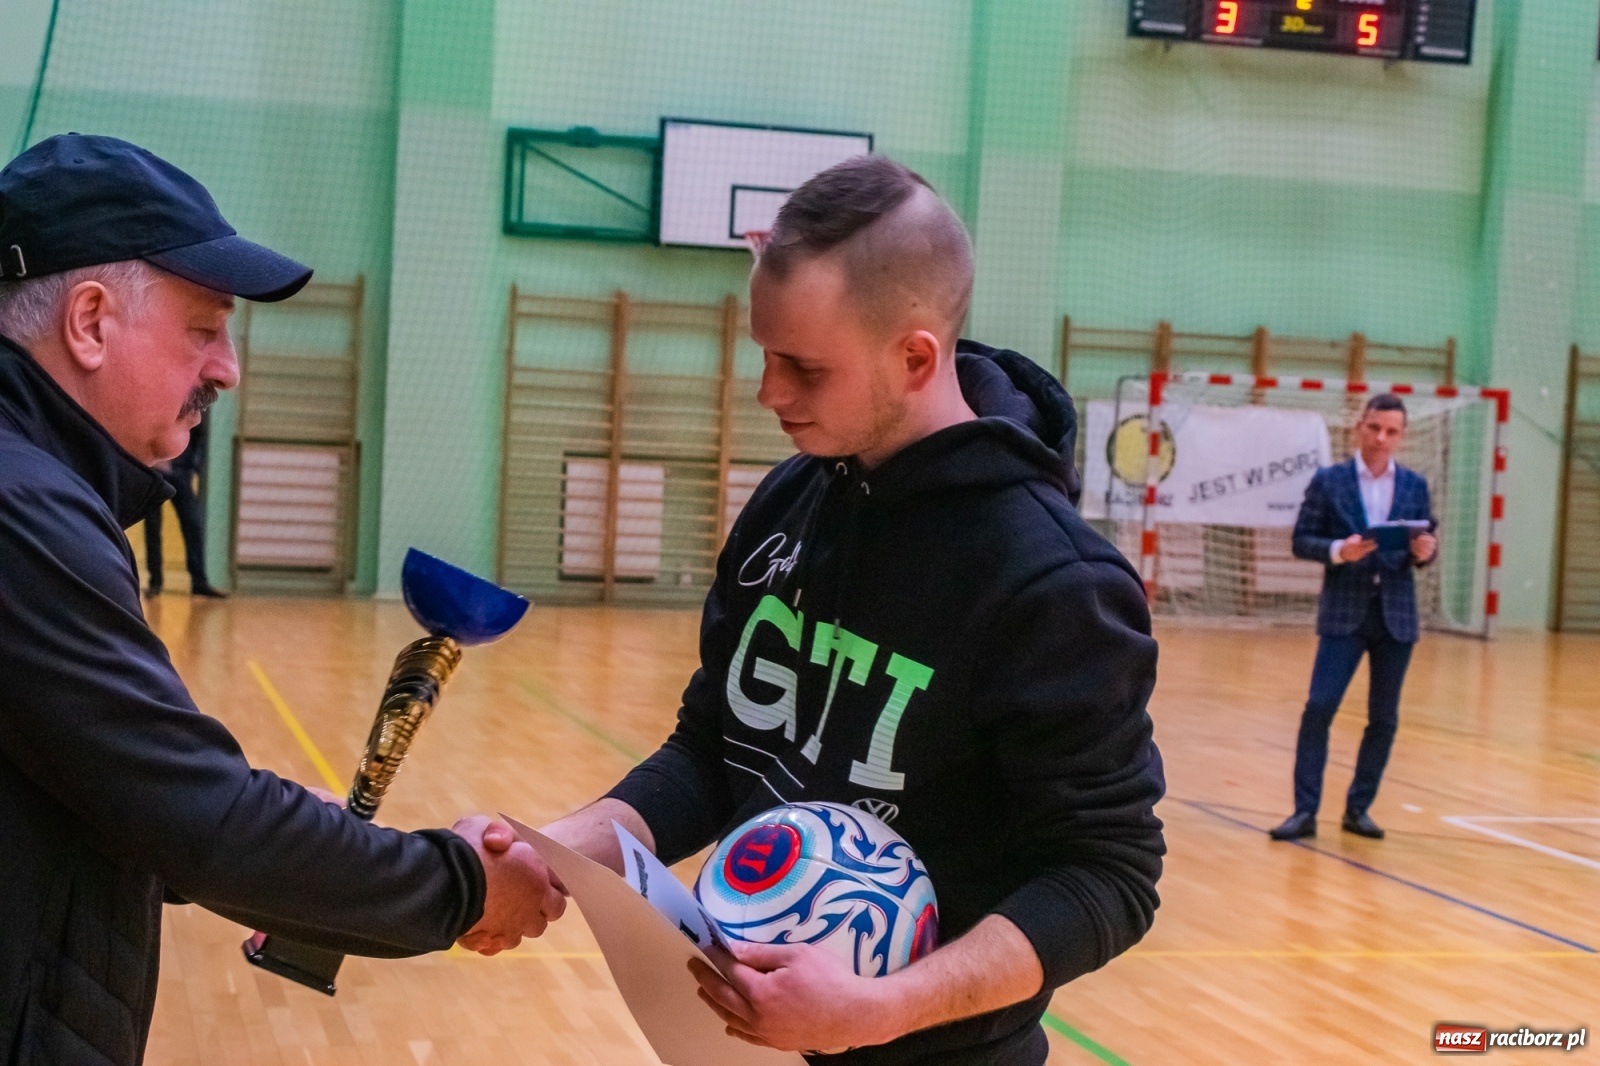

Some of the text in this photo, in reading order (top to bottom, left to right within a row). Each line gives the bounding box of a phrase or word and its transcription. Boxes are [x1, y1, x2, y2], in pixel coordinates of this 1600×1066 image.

[1215, 1, 1238, 34] 3
[1356, 14, 1379, 46] 5
[1190, 474, 1236, 503] JEST
[1246, 466, 1264, 486] W
[726, 594, 935, 791] GTI
